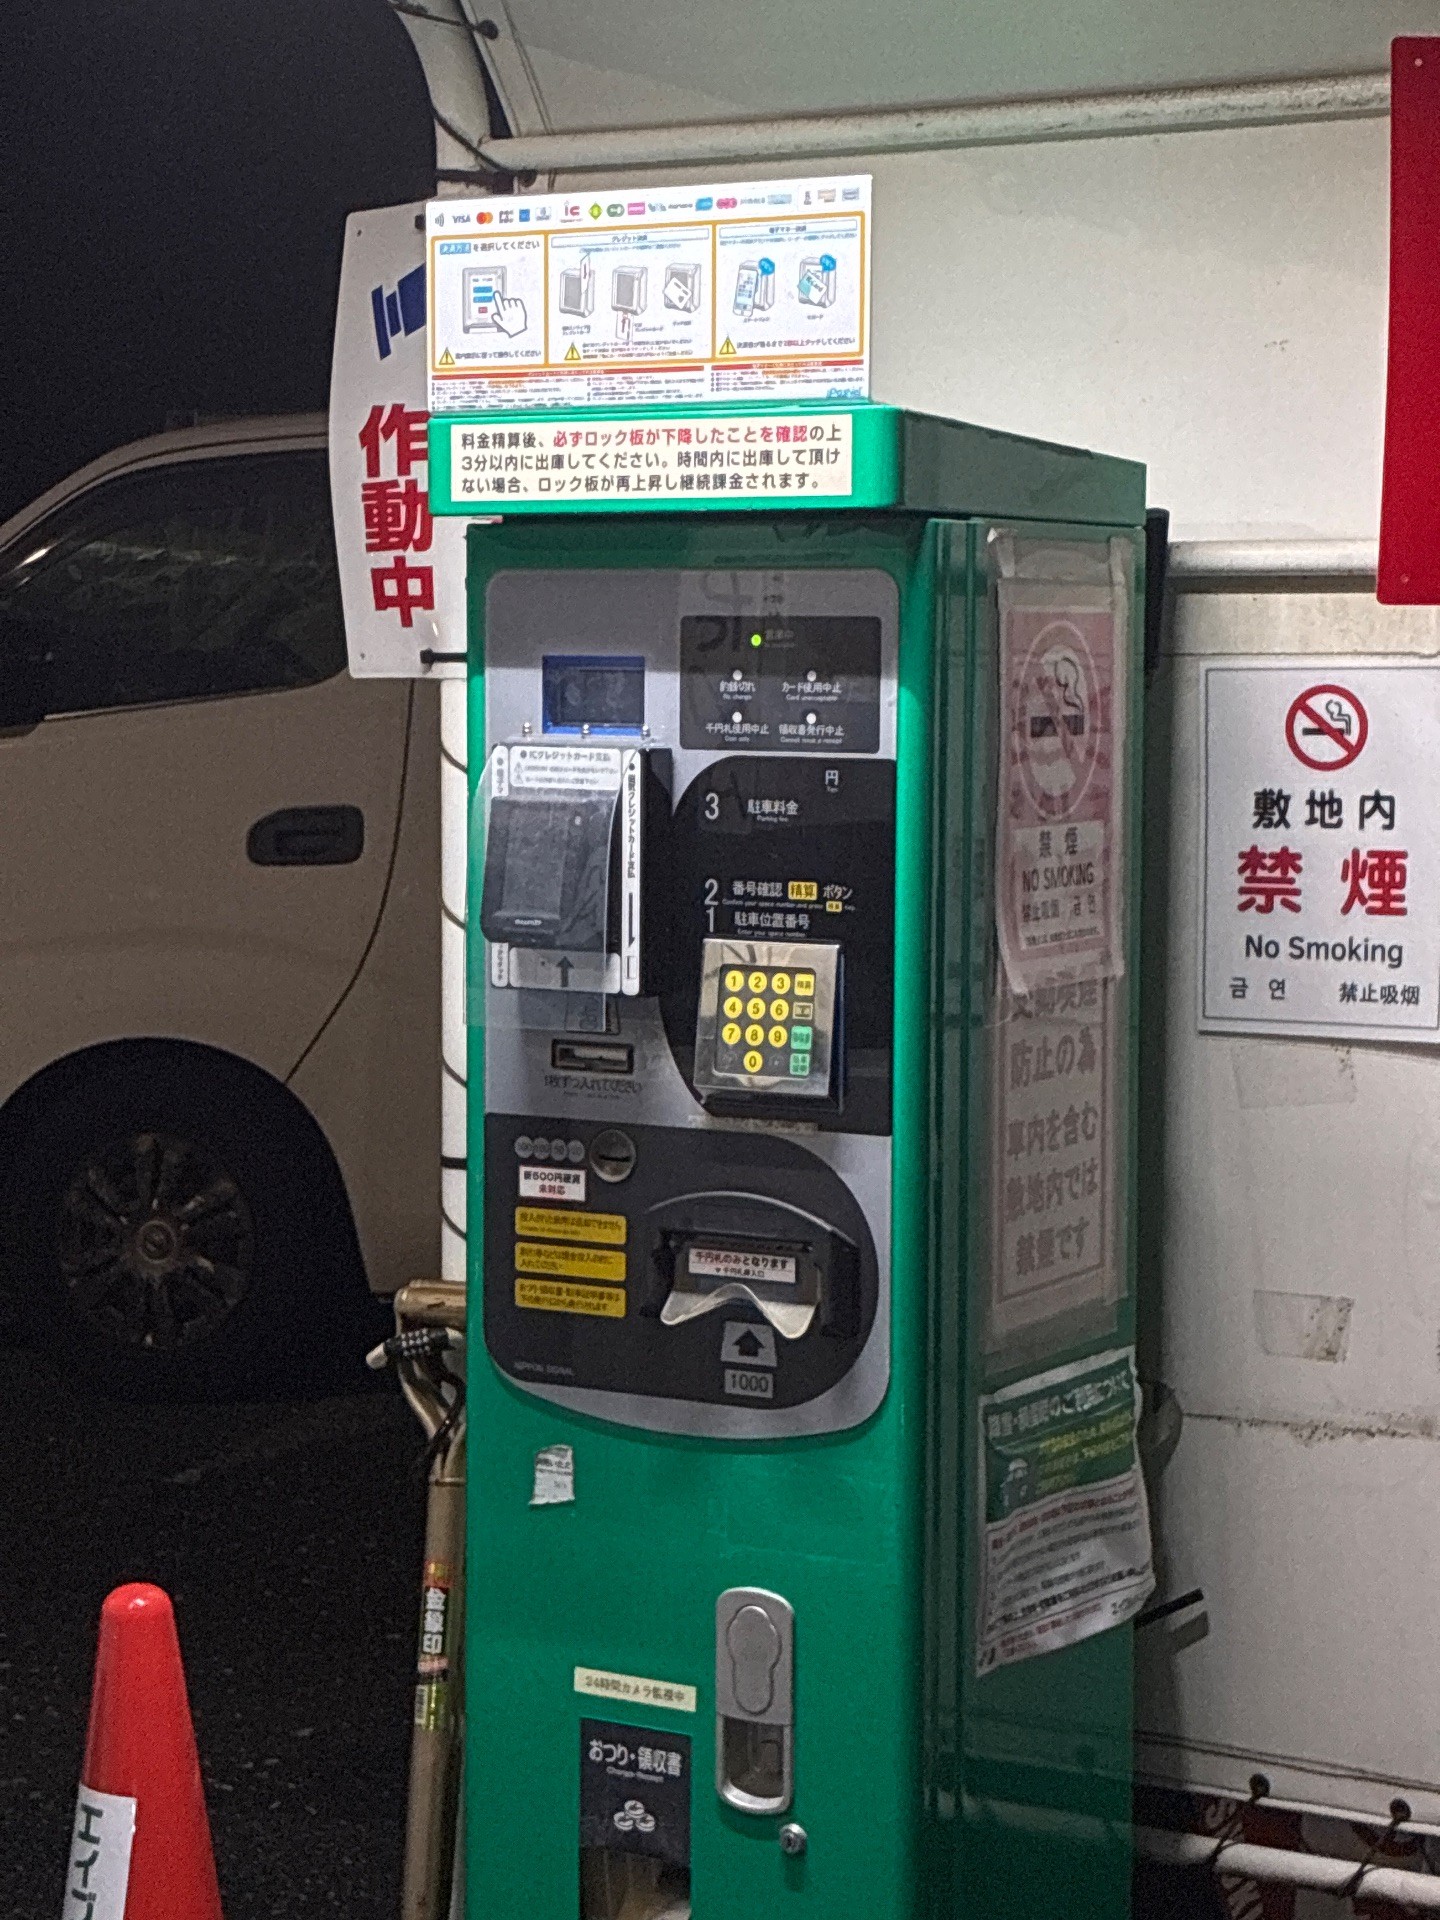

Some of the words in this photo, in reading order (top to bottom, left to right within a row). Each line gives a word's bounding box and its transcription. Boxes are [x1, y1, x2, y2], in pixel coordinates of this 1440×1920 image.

[452, 215, 470, 224] VISA
[461, 423, 842, 450] 料金精算後、必ずロック板が下降したことを確認の上
[461, 447, 841, 472] 3分以内に出庫してください。時間内に出庫して頂け
[461, 472, 819, 494] ない場合、ロック板が再上昇し継続課金されます。
[358, 403, 434, 628] 作動中
[781, 681, 842, 694] カード使用中止
[705, 723, 770, 735] 千円札使用中止
[778, 723, 845, 736] 領収書発行中止
[529, 750, 611, 762] ICクレジットカード支払
[824, 770, 839, 786] 円
[704, 792, 719, 820] 3
[747, 799, 799, 816] 駐車料金
[1252, 788, 1396, 831] 敷地内
[1022, 868, 1039, 892] NO
[1043, 862, 1095, 889] SMOKING
[1237, 845, 1408, 917] 禁煙
[704, 878, 719, 906] 2
[732, 880, 783, 897] 番号確認
[790, 883, 816, 899] 精算
[822, 885, 853, 900] ボタン
[704, 906, 715, 933] 1
[733, 912, 810, 930] 駐車位置番号
[1245, 934, 1280, 959] No
[1289, 934, 1404, 969] Smoking
[730, 975, 737, 987] 1
[754, 976, 762, 989] 2
[776, 977, 785, 990] 3
[1339, 981, 1420, 1007] 禁止吸烟
[728, 1001, 737, 1013] 4
[752, 1002, 760, 1015] 5
[775, 1004, 783, 1016] 6
[727, 1028, 735, 1040] 7
[750, 1029, 759, 1042] 8
[773, 1030, 782, 1043] 9
[749, 1055, 757, 1068] 0
[523, 1170, 581, 1185] 新500円硬貨
[538, 1184, 566, 1196] 未対応
[694, 1251, 789, 1269] 千円札のみとなります
[730, 1373, 769, 1393] 1000
[588, 1739, 683, 1778] おつり・領収書
